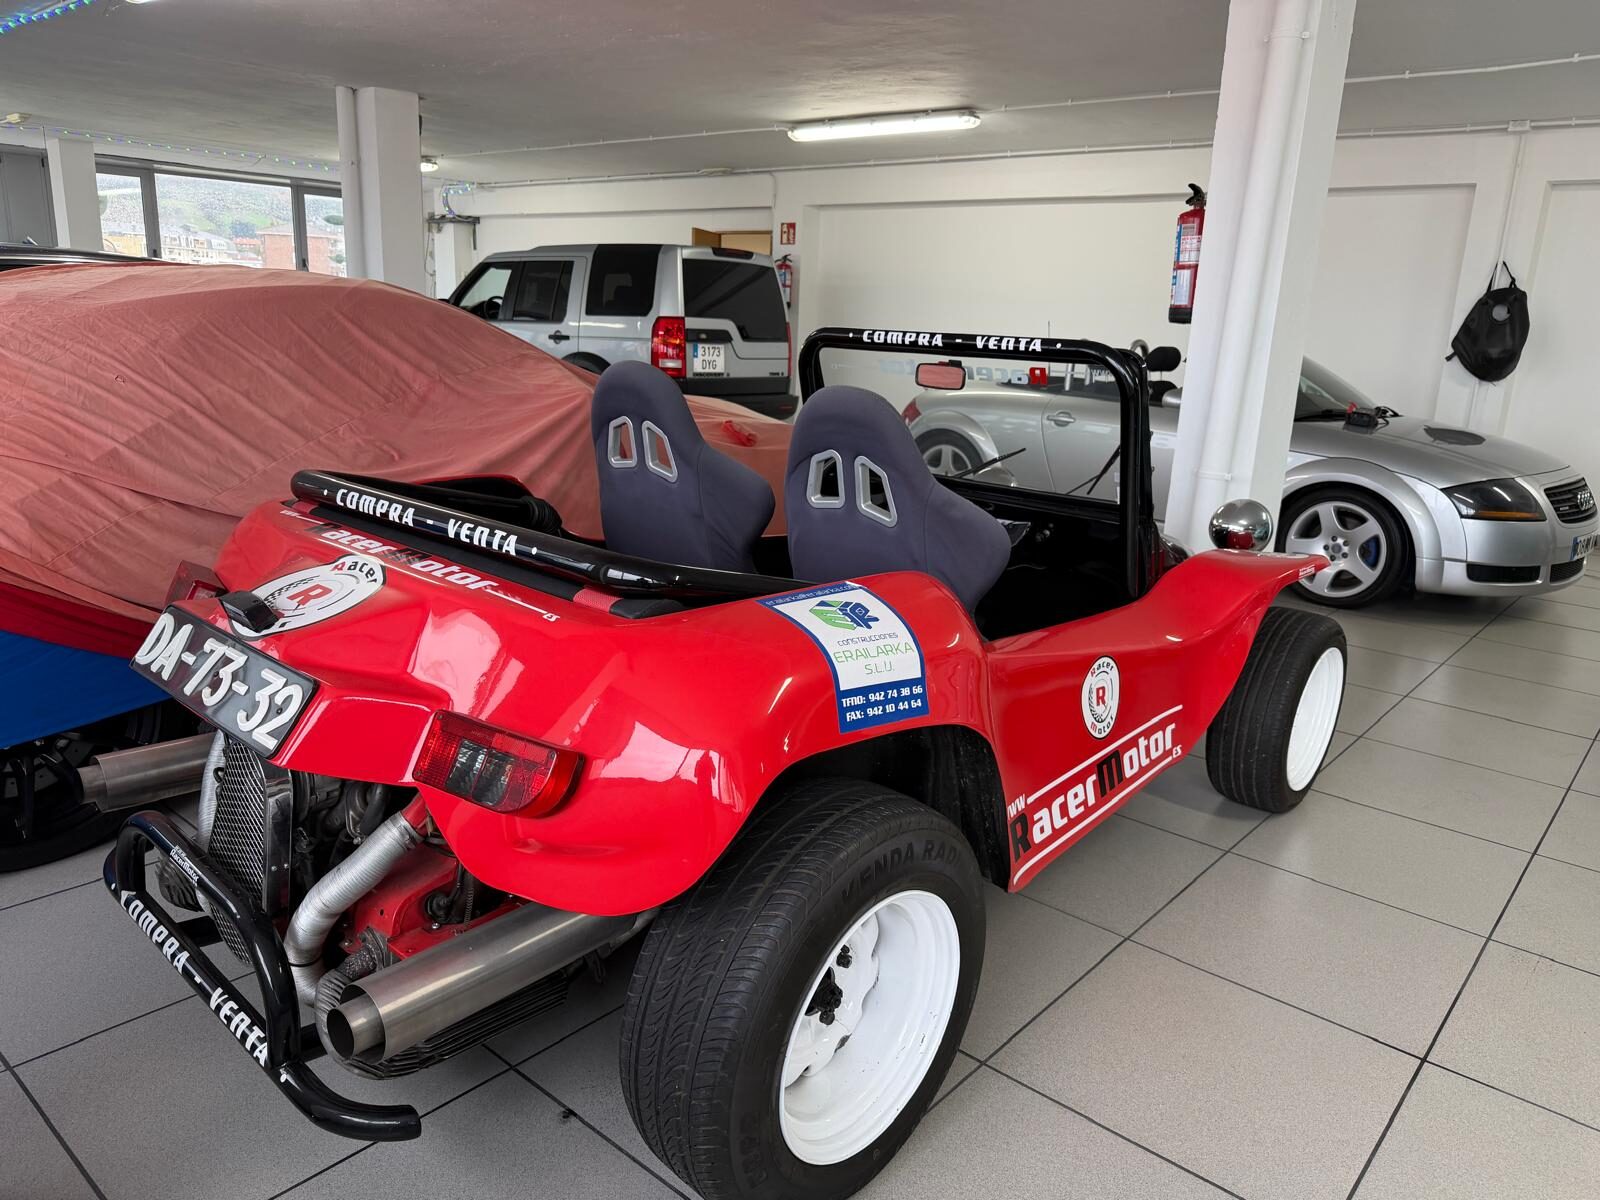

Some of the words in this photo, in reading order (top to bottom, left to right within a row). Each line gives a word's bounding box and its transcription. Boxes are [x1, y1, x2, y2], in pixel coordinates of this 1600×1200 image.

[701, 346, 721, 357] 3173
[863, 329, 944, 347] COMPRA
[975, 335, 1042, 352] VENTA
[701, 359, 717, 370] DYG
[335, 488, 415, 527] COMPRA
[447, 518, 519, 555] VENTA
[330, 561, 377, 584] Racer
[286, 583, 333, 607] R
[837, 632, 899, 647] CONSTRUCCIONES
[833, 641, 915, 664] ERAILARKA
[864, 661, 895, 675] S.L.U.
[1090, 661, 1114, 677] Racer
[135, 612, 303, 750] DA-73-32
[868, 690, 885, 702] 942
[886, 689, 898, 699] 74
[899, 687, 910, 697] 38
[912, 685, 923, 695] 66
[1096, 686, 1106, 706] R
[846, 711, 864, 722] FAX:
[866, 705, 883, 717] 942
[885, 703, 895, 714] 10
[897, 701, 909, 711] 44
[910, 698, 922, 709] 64
[1090, 713, 1114, 735] Motor
[1009, 723, 1176, 863] RacerMotor
[169, 848, 200, 882] RacerMotor
[120, 890, 190, 975] COMPRA
[209, 987, 268, 1067] VENTA
